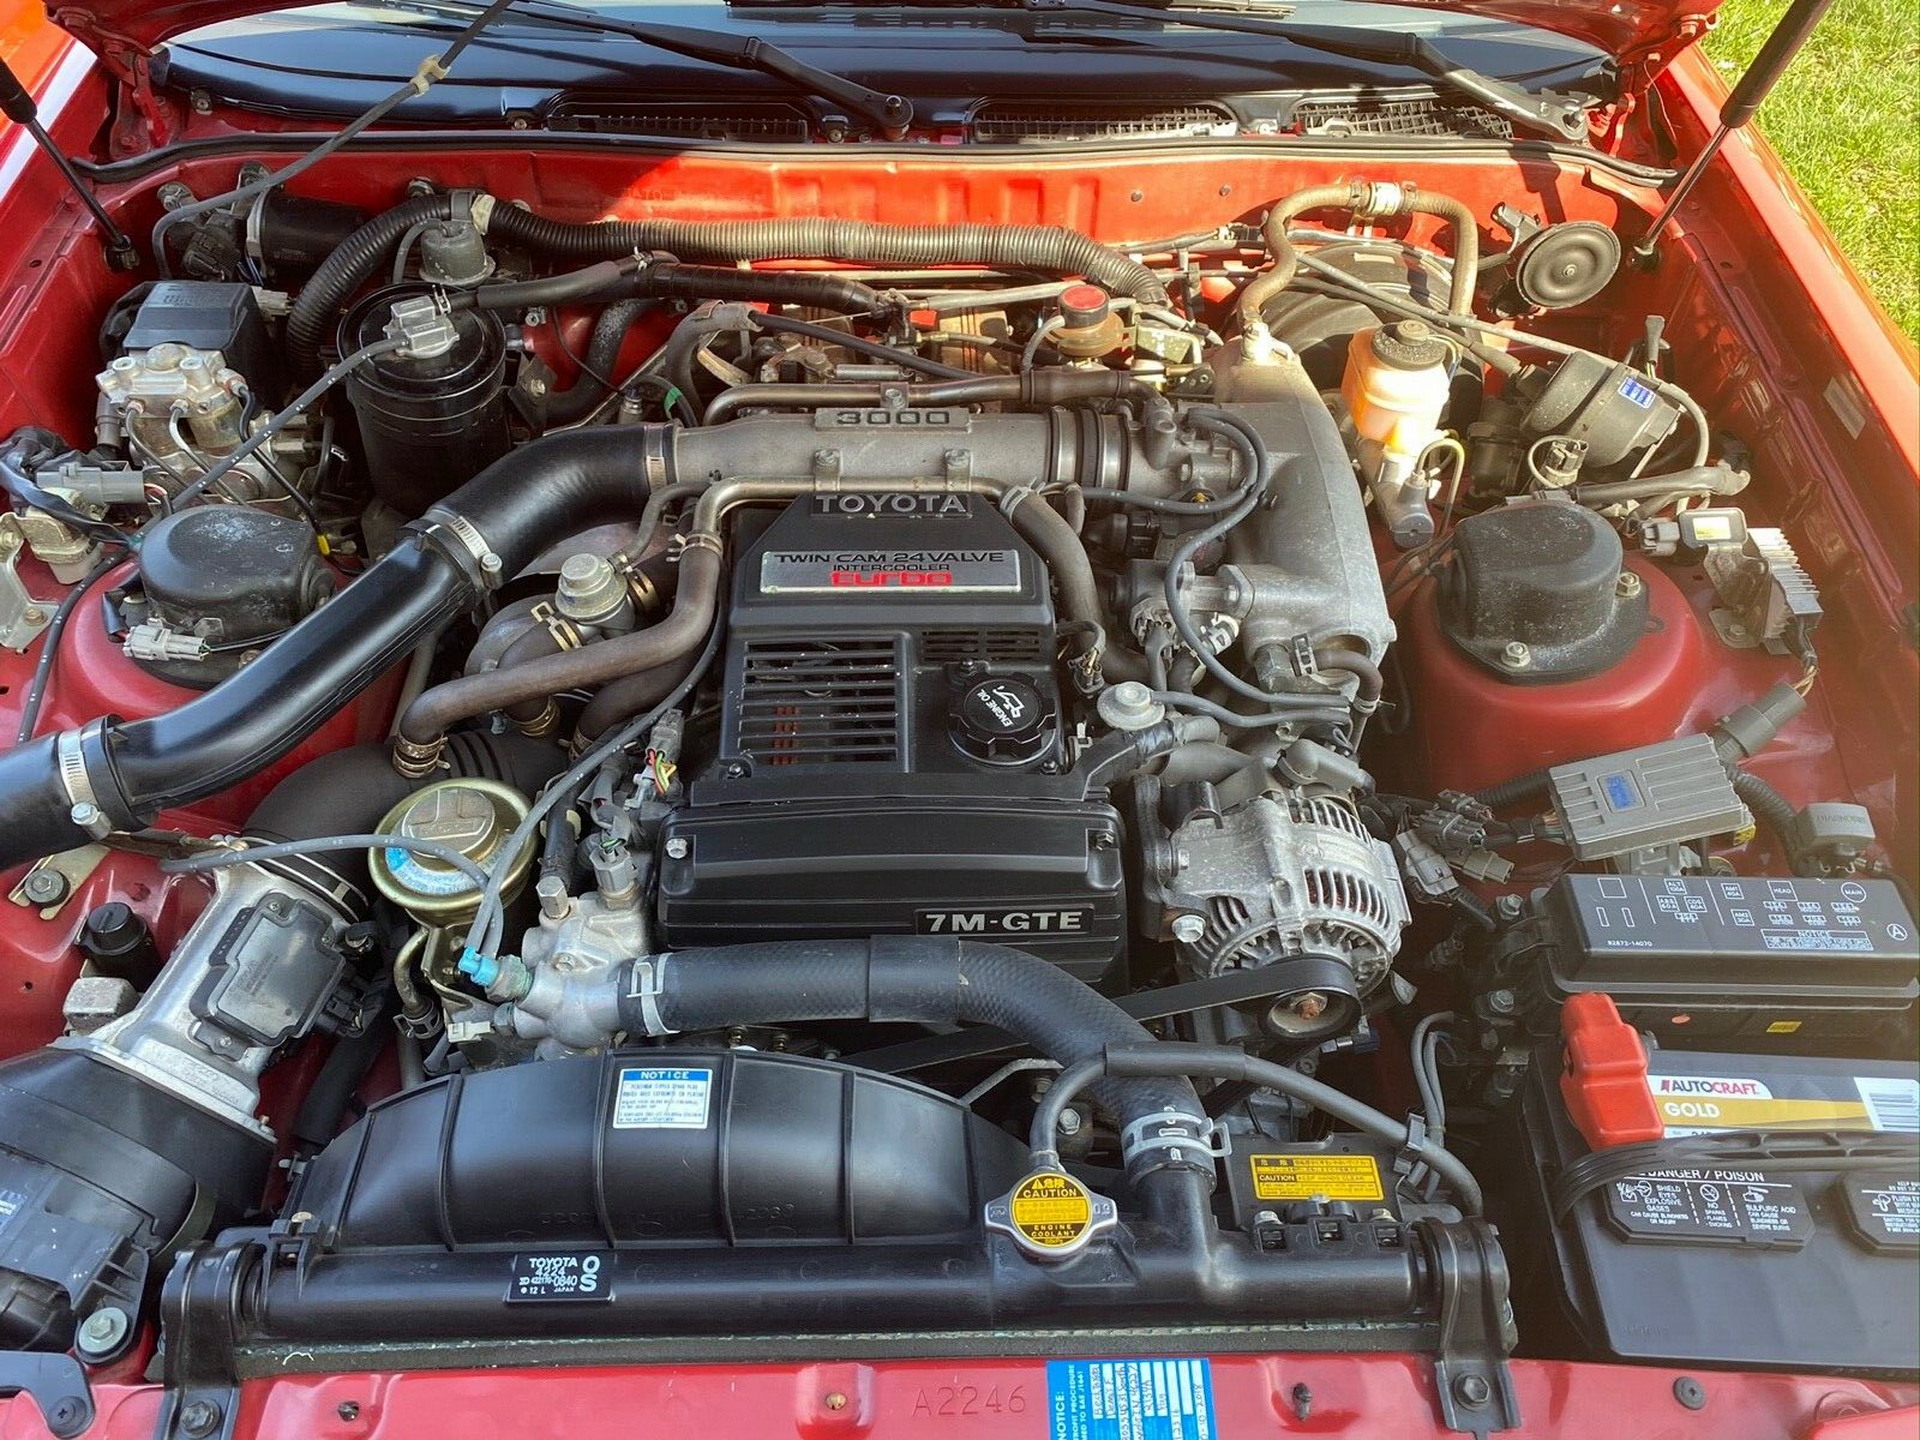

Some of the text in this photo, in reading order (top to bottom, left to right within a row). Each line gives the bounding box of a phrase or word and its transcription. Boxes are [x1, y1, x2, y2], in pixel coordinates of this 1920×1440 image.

[836, 410, 950, 426] 3000
[815, 494, 967, 513] TOYOTA
[774, 554, 830, 563] TWIN
[836, 553, 886, 563] CAM
[977, 689, 1013, 728] ENGINE OIL
[926, 911, 1083, 932] 7M-GTE
[641, 1071, 690, 1079] NOTICE
[1672, 1080, 1757, 1095] AUTOCRAFT
[1664, 1103, 1721, 1118] GOLD
[1714, 1170, 1765, 1182] POISON
[1023, 1188, 1077, 1198] CAUTION
[1656, 1184, 1681, 1192] SHIELD
[1644, 1197, 1682, 1206] EXPLOSIVE
[1745, 1204, 1797, 1214] SULFURIC ACID
[529, 1257, 578, 1268] TOYOTA
[535, 1267, 566, 1277] 4224
[1068, 1364, 1078, 1413] PROCEDURE
[912, 1385, 1026, 1417] A2246
[1055, 1391, 1067, 1440] NOTICE:
[1079, 1411, 1087, 1423] TO
